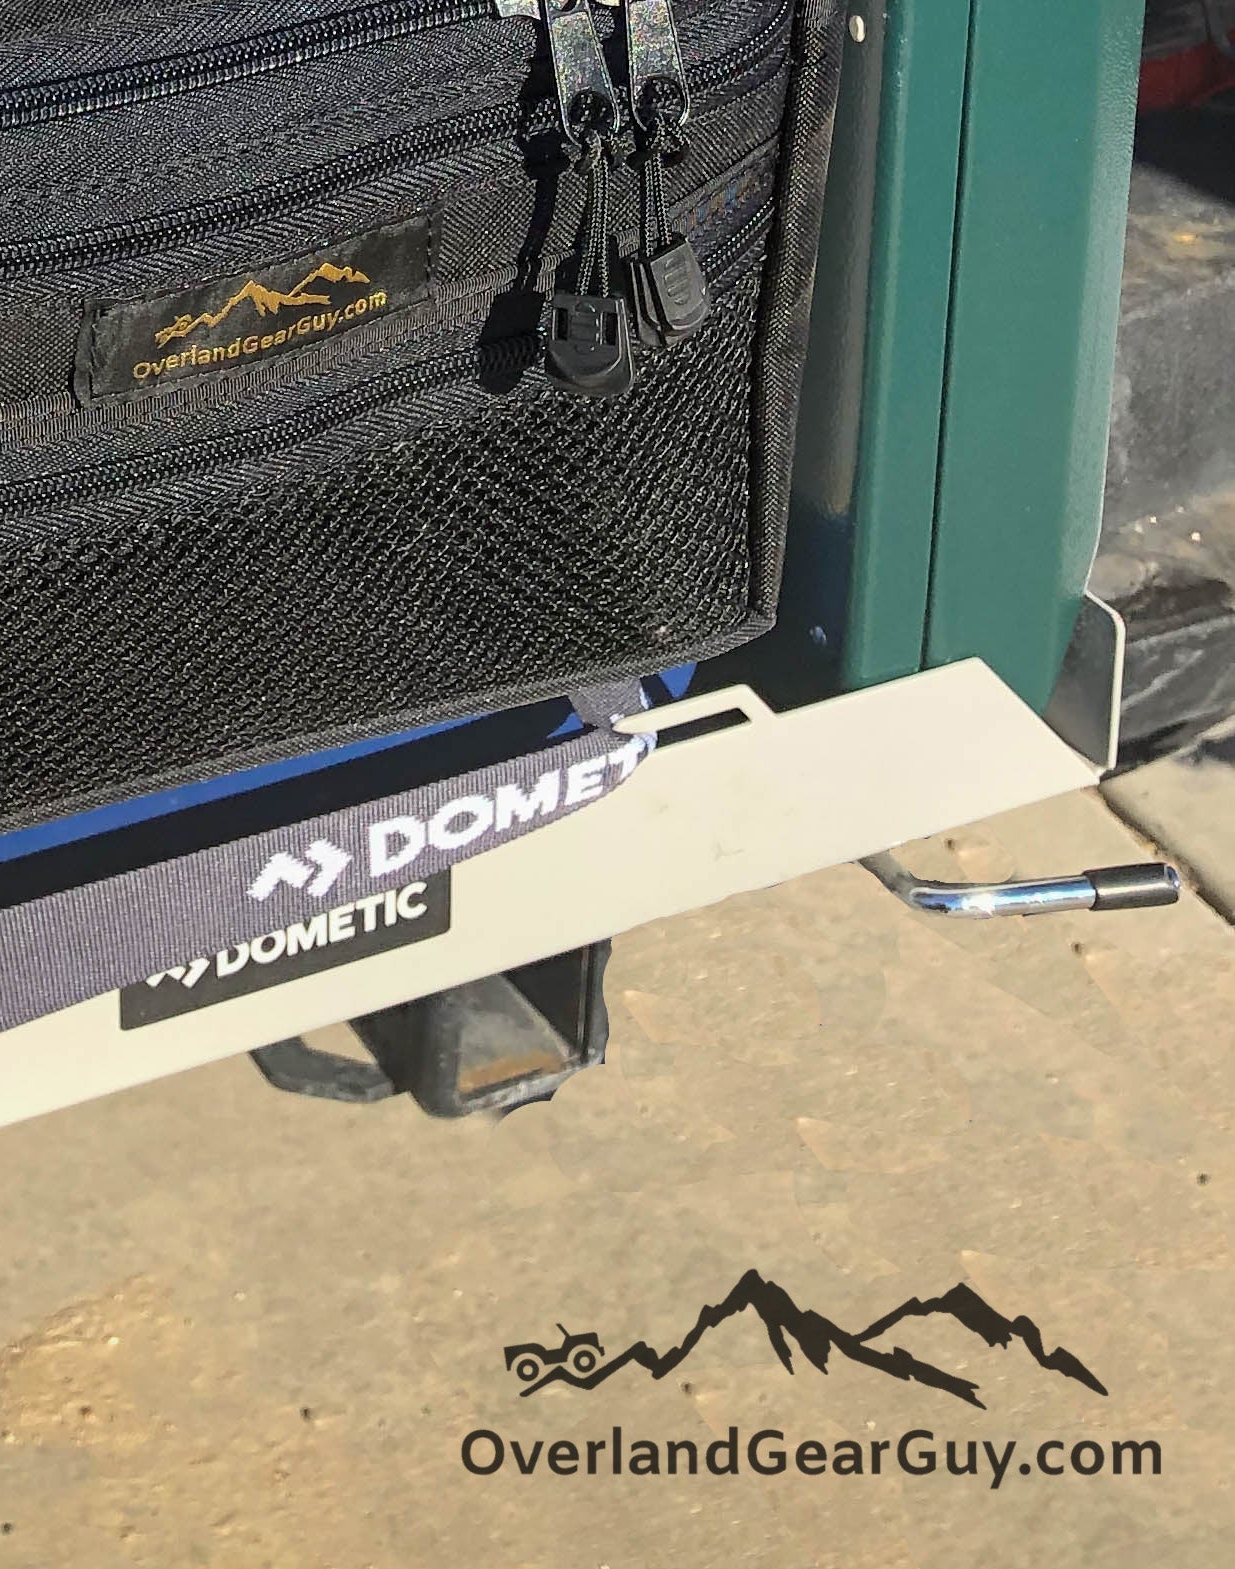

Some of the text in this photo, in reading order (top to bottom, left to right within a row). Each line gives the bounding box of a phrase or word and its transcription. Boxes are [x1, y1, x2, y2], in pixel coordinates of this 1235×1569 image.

[133, 290, 387, 380] OverlandGearGuy.com
[368, 732, 658, 879] DOMET
[216, 882, 428, 978] DOMETIC
